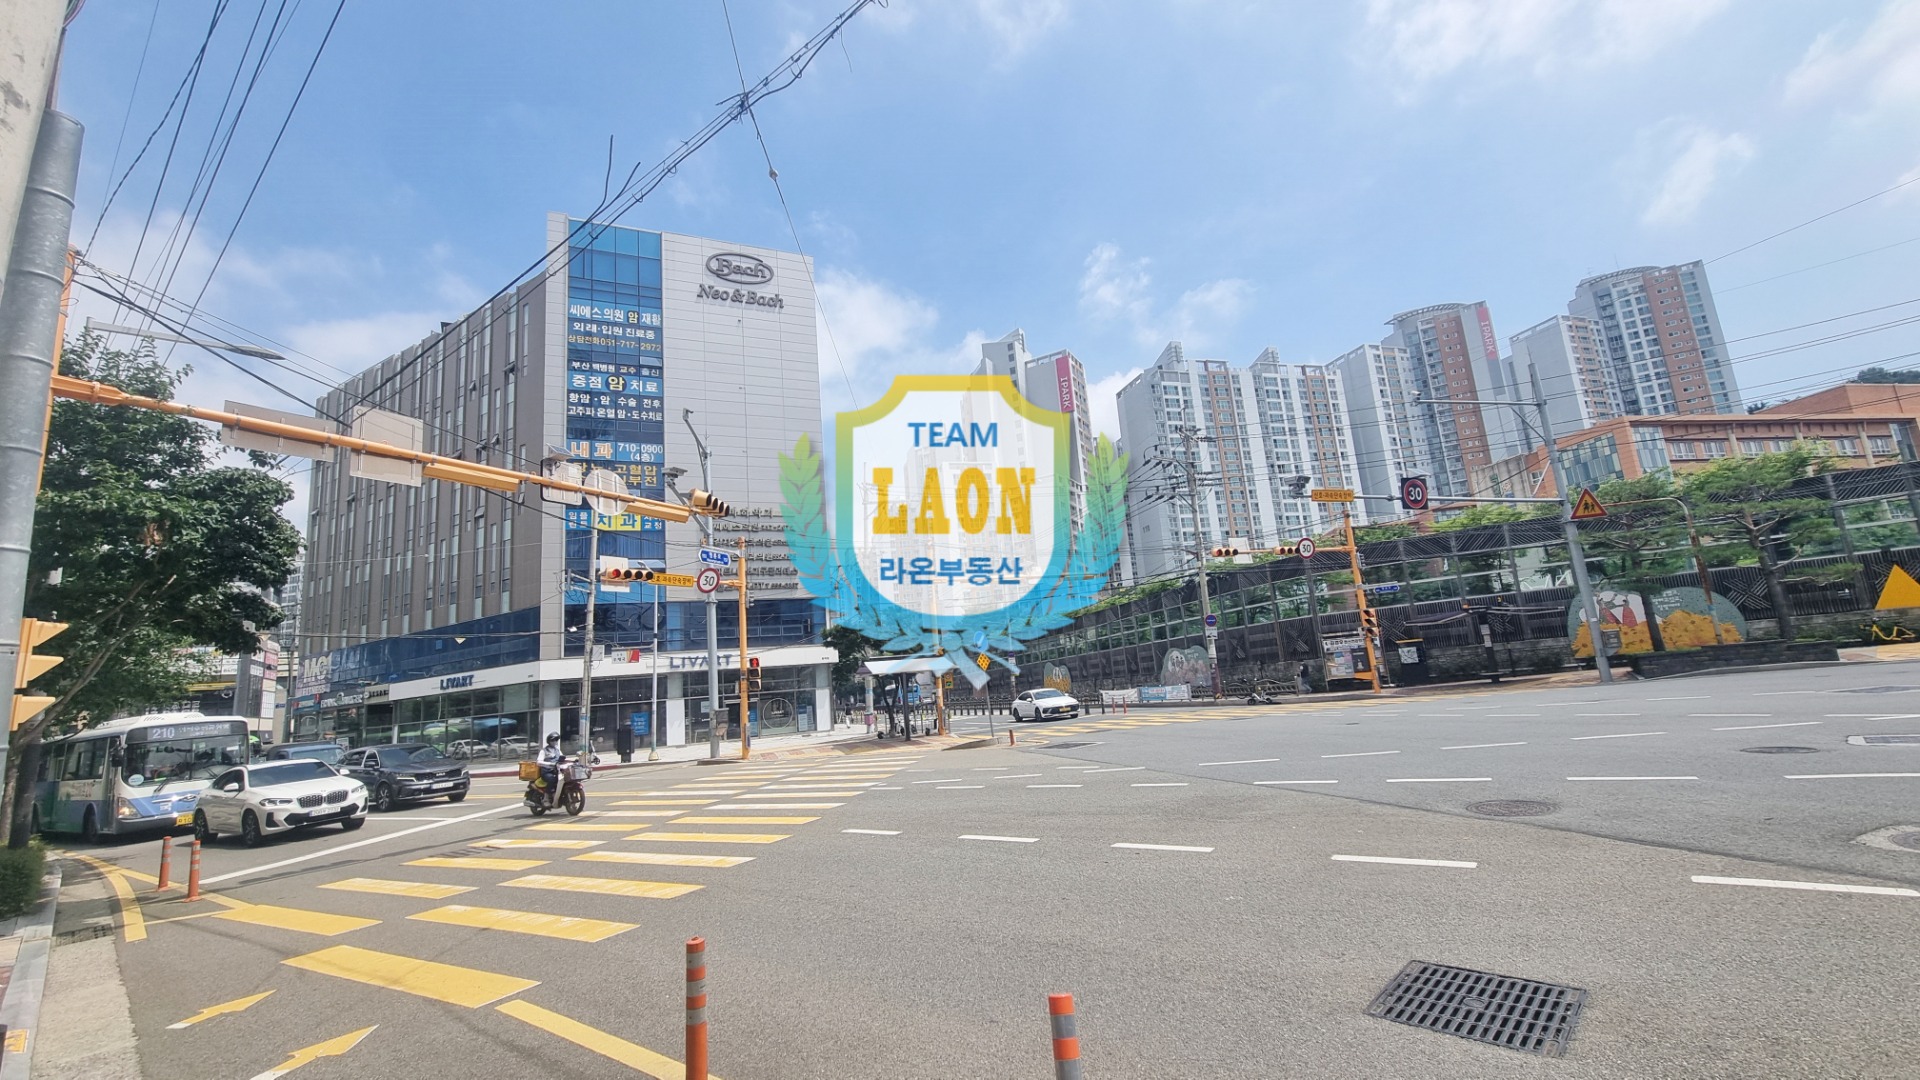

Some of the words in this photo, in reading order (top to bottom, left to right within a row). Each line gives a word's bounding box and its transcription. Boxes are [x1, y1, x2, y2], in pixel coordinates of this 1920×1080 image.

[715, 257, 768, 279] Bach
[569, 304, 624, 322] 씨에스의원
[627, 311, 639, 324] 암
[1481, 320, 1496, 353] IPARK
[619, 366, 637, 375] 교수
[571, 374, 602, 389] 중점
[608, 376, 625, 391] 암
[630, 380, 659, 393] 치료
[1060, 376, 1072, 409] IPARK
[617, 396, 637, 408] 수술
[642, 398, 662, 409] 전후
[617, 442, 664, 454] 710-0900
[630, 453, 655, 463] (4층)
[1408, 487, 1423, 501] 30
[1302, 544, 1312, 553] 30
[702, 575, 715, 587] 30
[152, 727, 176, 739] 210
